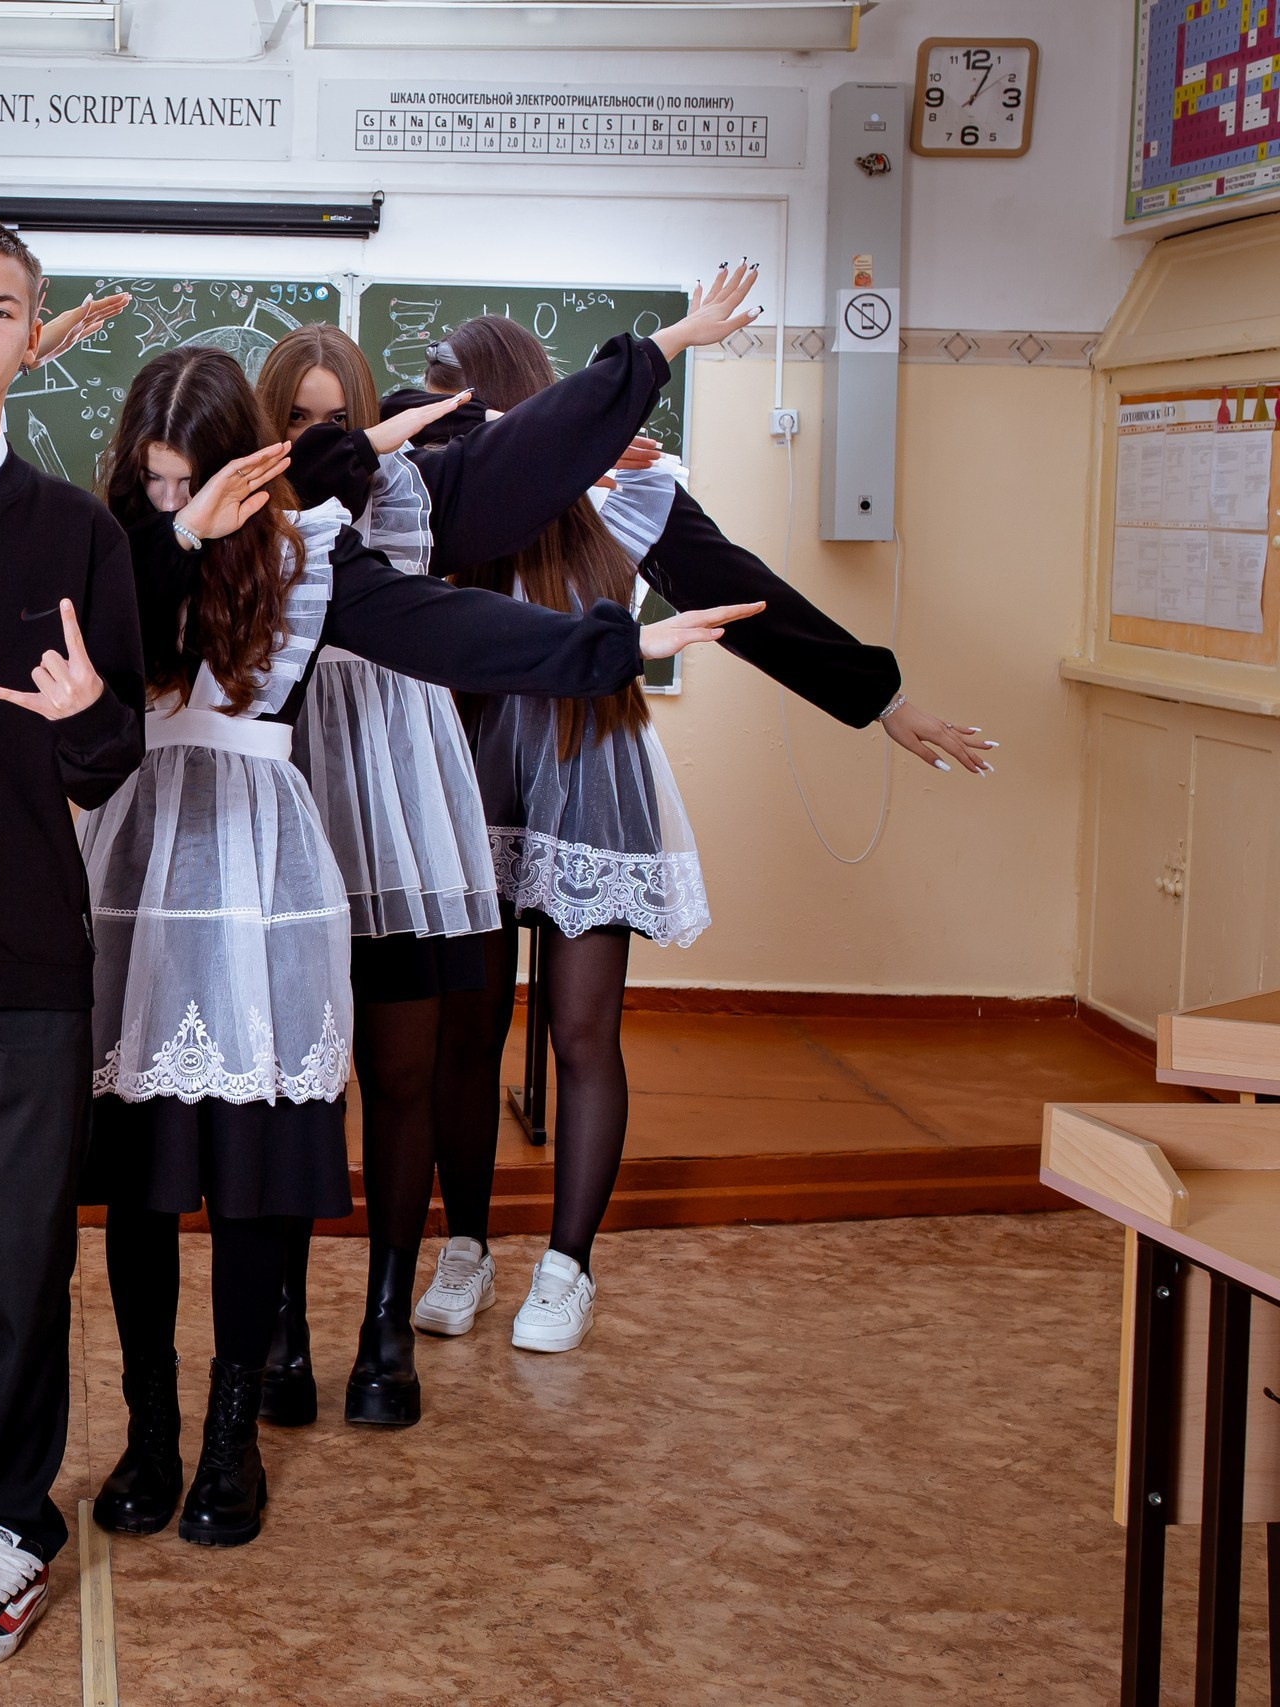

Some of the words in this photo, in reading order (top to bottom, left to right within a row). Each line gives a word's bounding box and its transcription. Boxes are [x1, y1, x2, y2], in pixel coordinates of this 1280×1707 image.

[950, 56, 959, 64] 11
[962, 49, 992, 70] 12
[997, 56, 1002, 64] 1
[929, 73, 942, 82] 10
[1008, 73, 1017, 82] 2
[390, 92, 426, 105] ШКАЛА
[428, 92, 514, 106] ОТНОСИТЕЛЬНОЙ
[515, 94, 655, 109] ЭЛЕКТРООТРИЦАТЕЛЬНОСТИ
[667, 97, 682, 108] ПО
[684, 97, 735, 112] ПОЛИНГУ)
[924, 87, 945, 108] 9
[1002, 87, 1022, 108] 3
[49, 95, 159, 124] SCRIPTA
[164, 97, 282, 127] MANENT
[928, 113, 937, 122] 8
[1005, 113, 1014, 122] 4
[363, 115, 375, 127] Cs
[390, 115, 396, 127] K
[410, 116, 423, 128] Na
[435, 116, 447, 128] Ca
[458, 115, 473, 129] Mg
[510, 117, 517, 129] B
[534, 117, 541, 129] P
[558, 118, 565, 130] H
[606, 118, 613, 131] S
[652, 119, 664, 132] Br
[703, 120, 710, 132] N
[752, 121, 758, 133] F
[945, 132, 953, 141] 7
[960, 125, 980, 146] 6
[989, 132, 997, 142] 5
